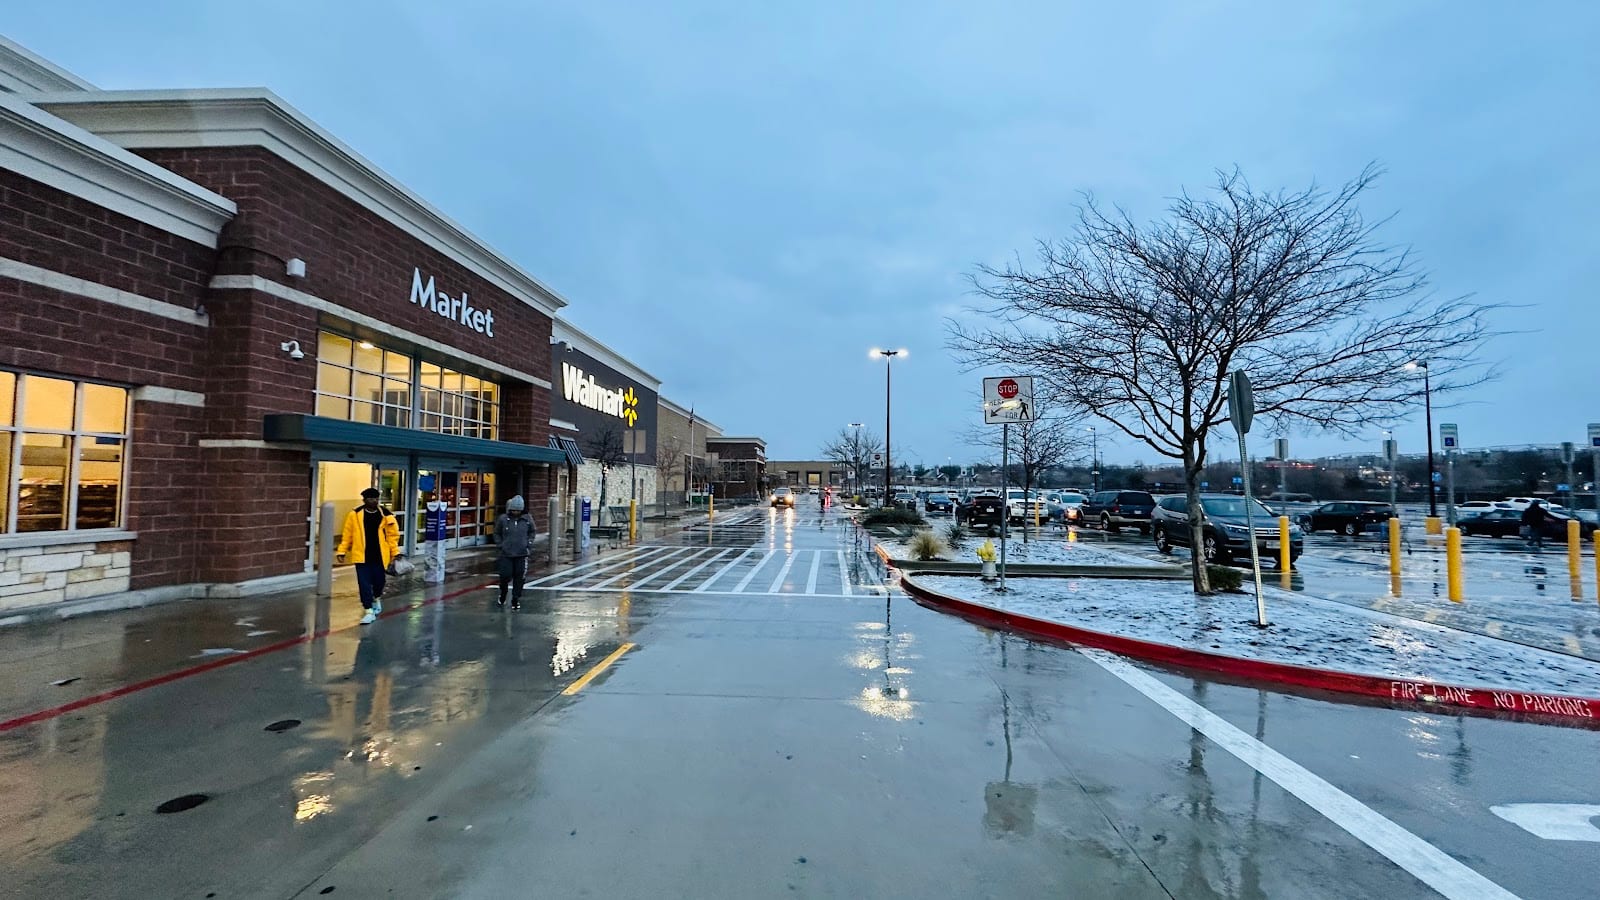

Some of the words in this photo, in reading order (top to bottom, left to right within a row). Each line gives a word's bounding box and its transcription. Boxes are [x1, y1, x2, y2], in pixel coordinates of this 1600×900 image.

[410, 267, 495, 338] Market
[562, 361, 625, 419] Walmart
[998, 385, 1018, 394] STOP
[1391, 681, 1424, 699] FIRE
[1432, 684, 1476, 704] LANE
[1492, 691, 1516, 709] NO
[1521, 693, 1593, 717] PARKING
